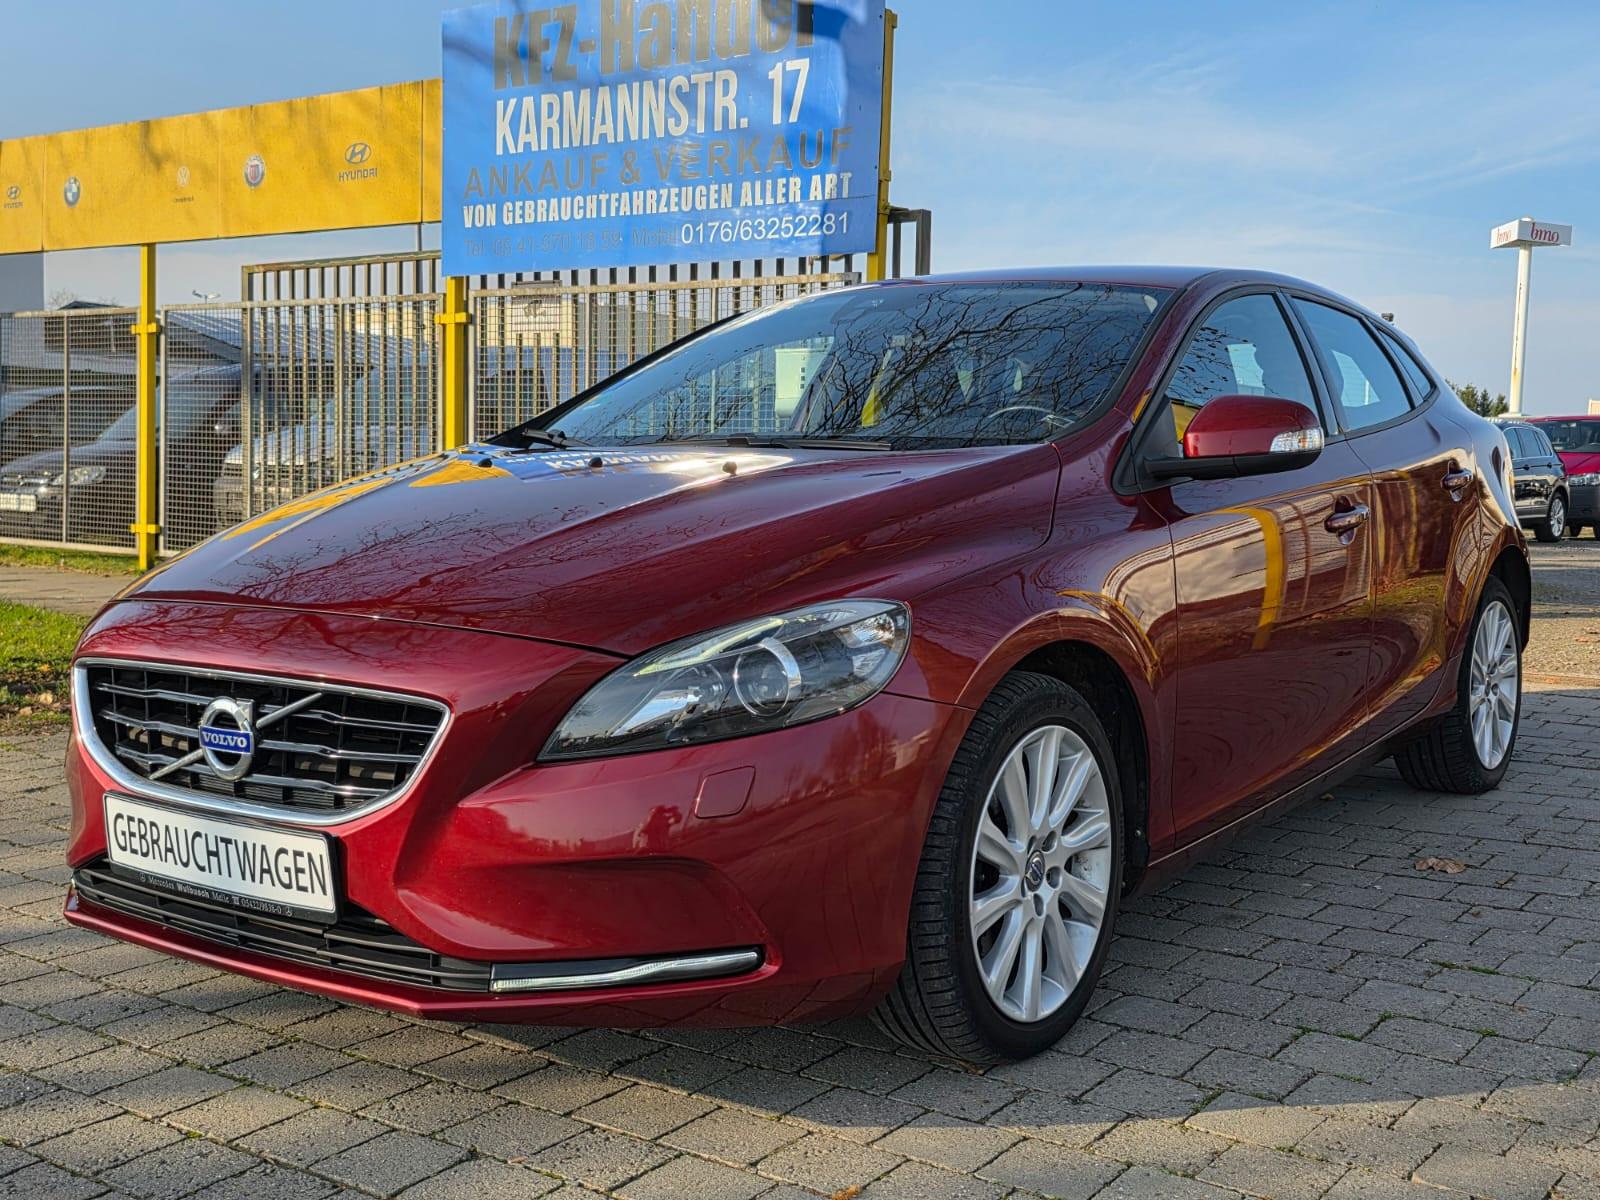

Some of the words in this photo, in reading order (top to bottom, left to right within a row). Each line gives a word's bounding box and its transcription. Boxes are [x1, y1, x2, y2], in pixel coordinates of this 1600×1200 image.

[495, 69, 748, 155] KARMANNSTR.
[768, 58, 811, 126] 17
[338, 167, 378, 182] HYUNDAI
[463, 151, 609, 199] ANKAUF
[619, 149, 641, 186] &
[654, 126, 854, 180] VERKAUF
[463, 204, 496, 229] VON
[503, 182, 733, 225] GEBRAUCHTFAHRZEUGEN
[740, 176, 801, 208] ALLER
[810, 172, 852, 200] ART
[680, 213, 849, 243] 0176/63252281
[1530, 222, 1559, 242] bmo
[202, 731, 248, 748] VOLVO
[113, 812, 328, 897] GEBRAUCHTWAGEN
